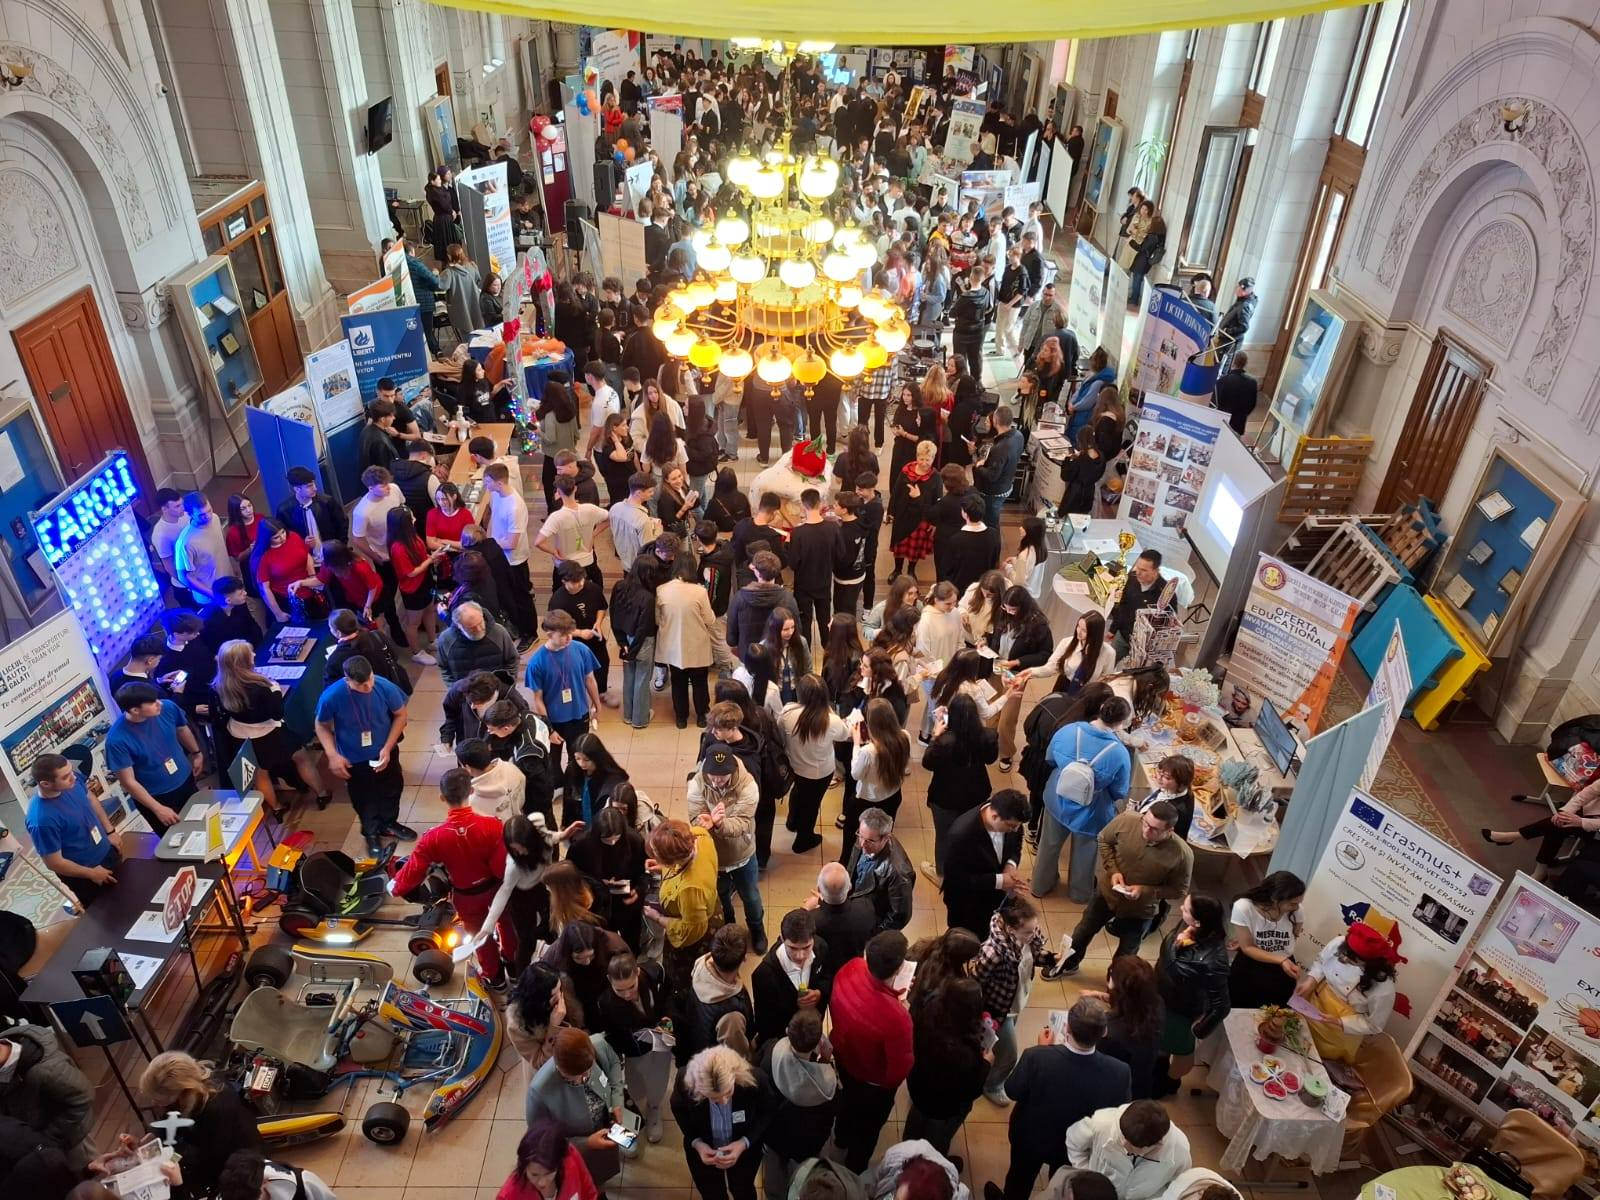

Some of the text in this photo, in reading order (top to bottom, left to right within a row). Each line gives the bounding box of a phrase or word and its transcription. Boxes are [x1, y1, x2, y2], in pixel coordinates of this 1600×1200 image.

[353, 347, 376, 356] LIBERTY
[391, 352, 412, 361] PENTRU
[37, 457, 136, 564] CAROLI
[1276, 607, 1318, 635] OFERTA
[2, 658, 23, 676] LICEUL
[6, 664, 27, 683] AUTO
[38, 675, 46, 687] pe
[1383, 822, 1462, 880] Erasmus+
[166, 873, 195, 928] STOP
[1423, 880, 1436, 890] CU
[1437, 888, 1475, 916] ERASMUS
[1256, 931, 1290, 939] MESERIA
